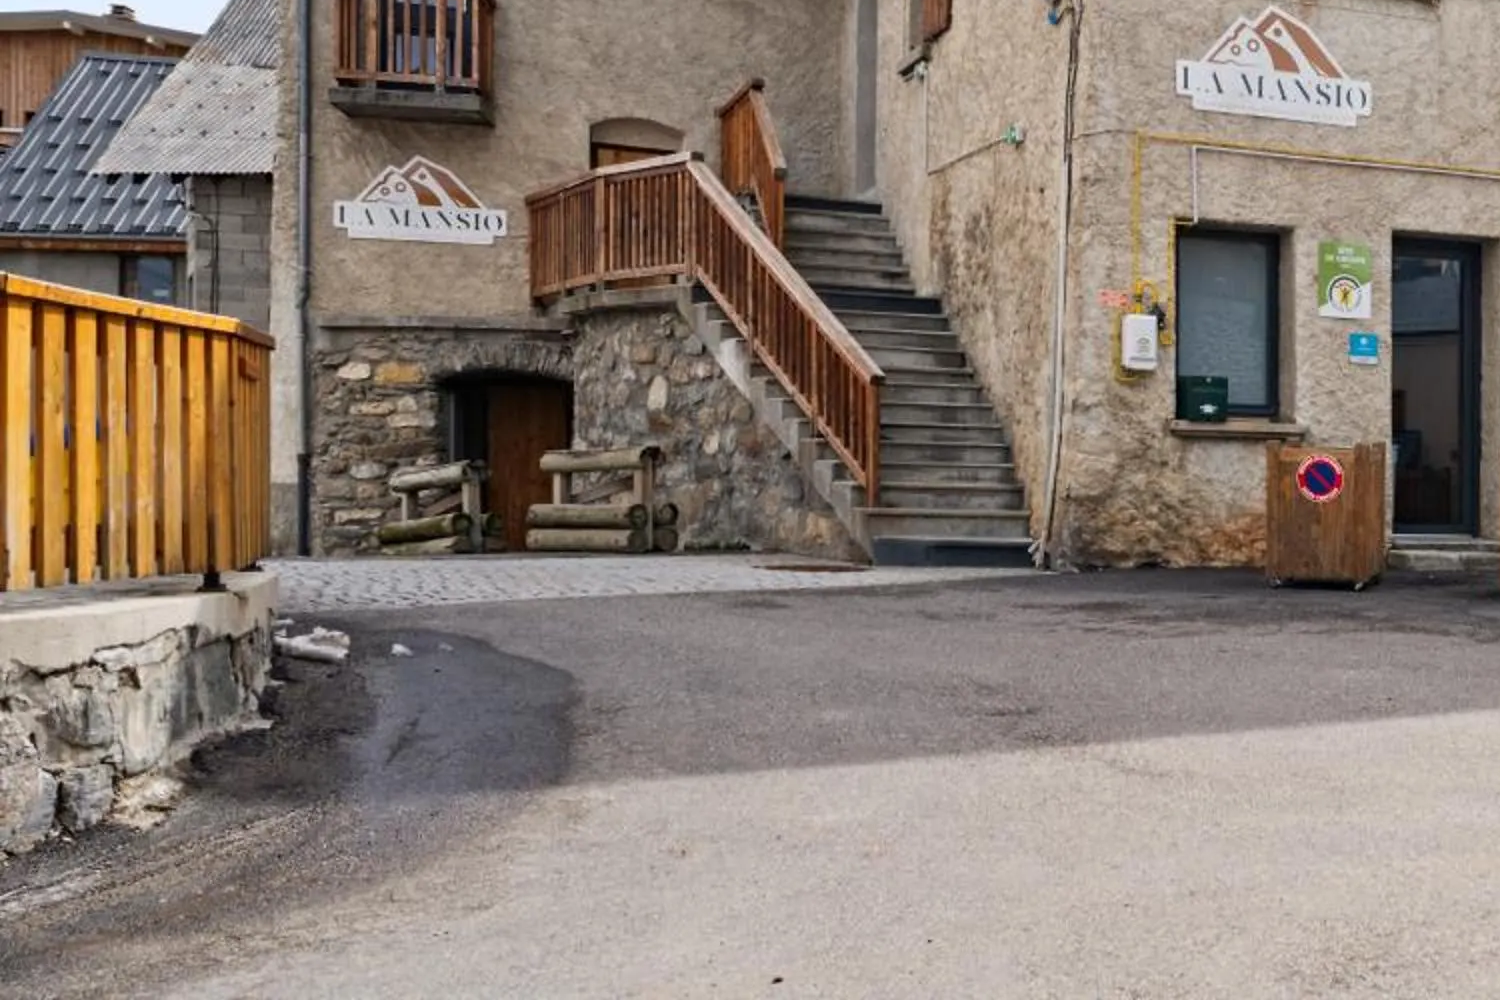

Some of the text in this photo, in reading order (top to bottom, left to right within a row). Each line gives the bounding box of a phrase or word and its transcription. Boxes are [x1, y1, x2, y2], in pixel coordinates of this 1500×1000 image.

[1183, 66, 1367, 109] LA MANSIO
[339, 205, 503, 231] LA MANSIO
